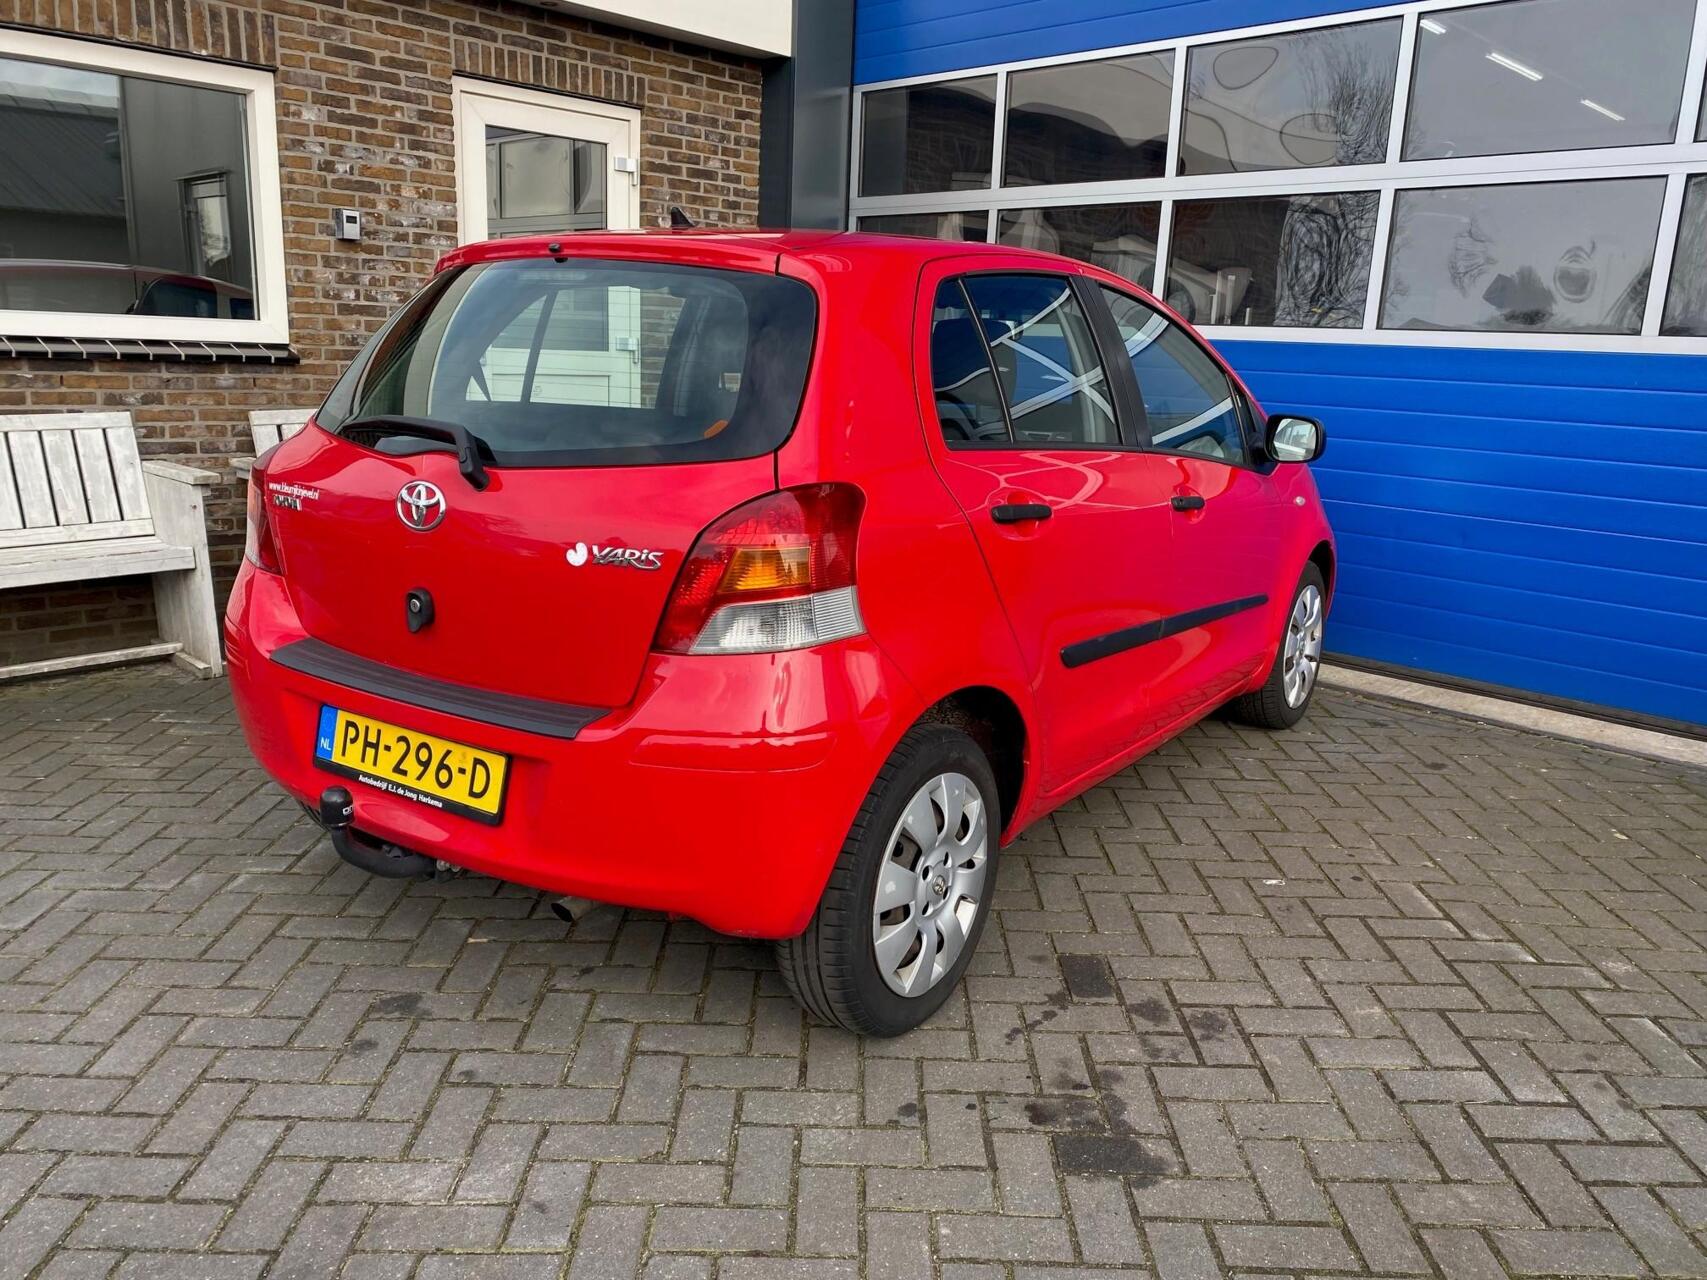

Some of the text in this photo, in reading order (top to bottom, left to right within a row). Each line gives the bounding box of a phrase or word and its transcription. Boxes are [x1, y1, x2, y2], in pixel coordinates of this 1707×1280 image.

[320, 737, 332, 751] NL
[341, 720, 491, 799] PH-296-D
[358, 774, 388, 791] Autobedrijf
[397, 787, 404, 795] de
[404, 790, 418, 801] Jong
[418, 794, 443, 808] Harkema
